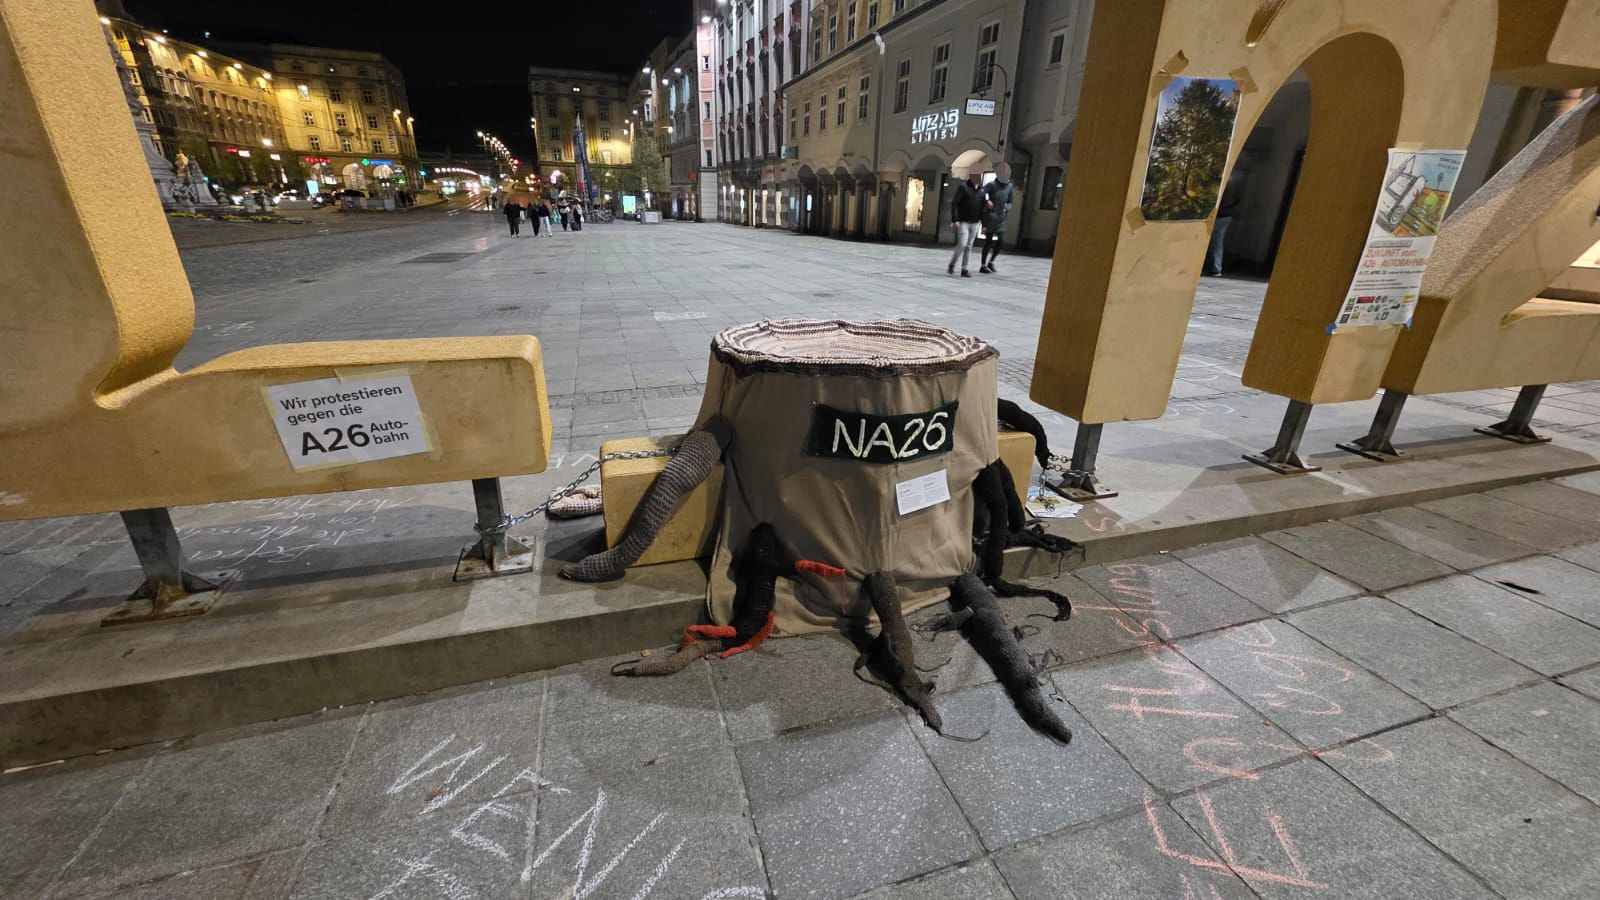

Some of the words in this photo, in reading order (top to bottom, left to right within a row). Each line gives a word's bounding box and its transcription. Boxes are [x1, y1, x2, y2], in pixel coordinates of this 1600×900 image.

[939, 108, 960, 129] AG
[1365, 248, 1402, 258] ZUKUNFT
[280, 397, 307, 411] Wir
[311, 385, 402, 409] protestieren
[287, 407, 335, 426] gegen
[339, 404, 363, 416] die
[370, 422, 409, 433] Auto-
[832, 411, 949, 460] NA26
[301, 423, 370, 456] A26
[373, 432, 410, 445] bahn
